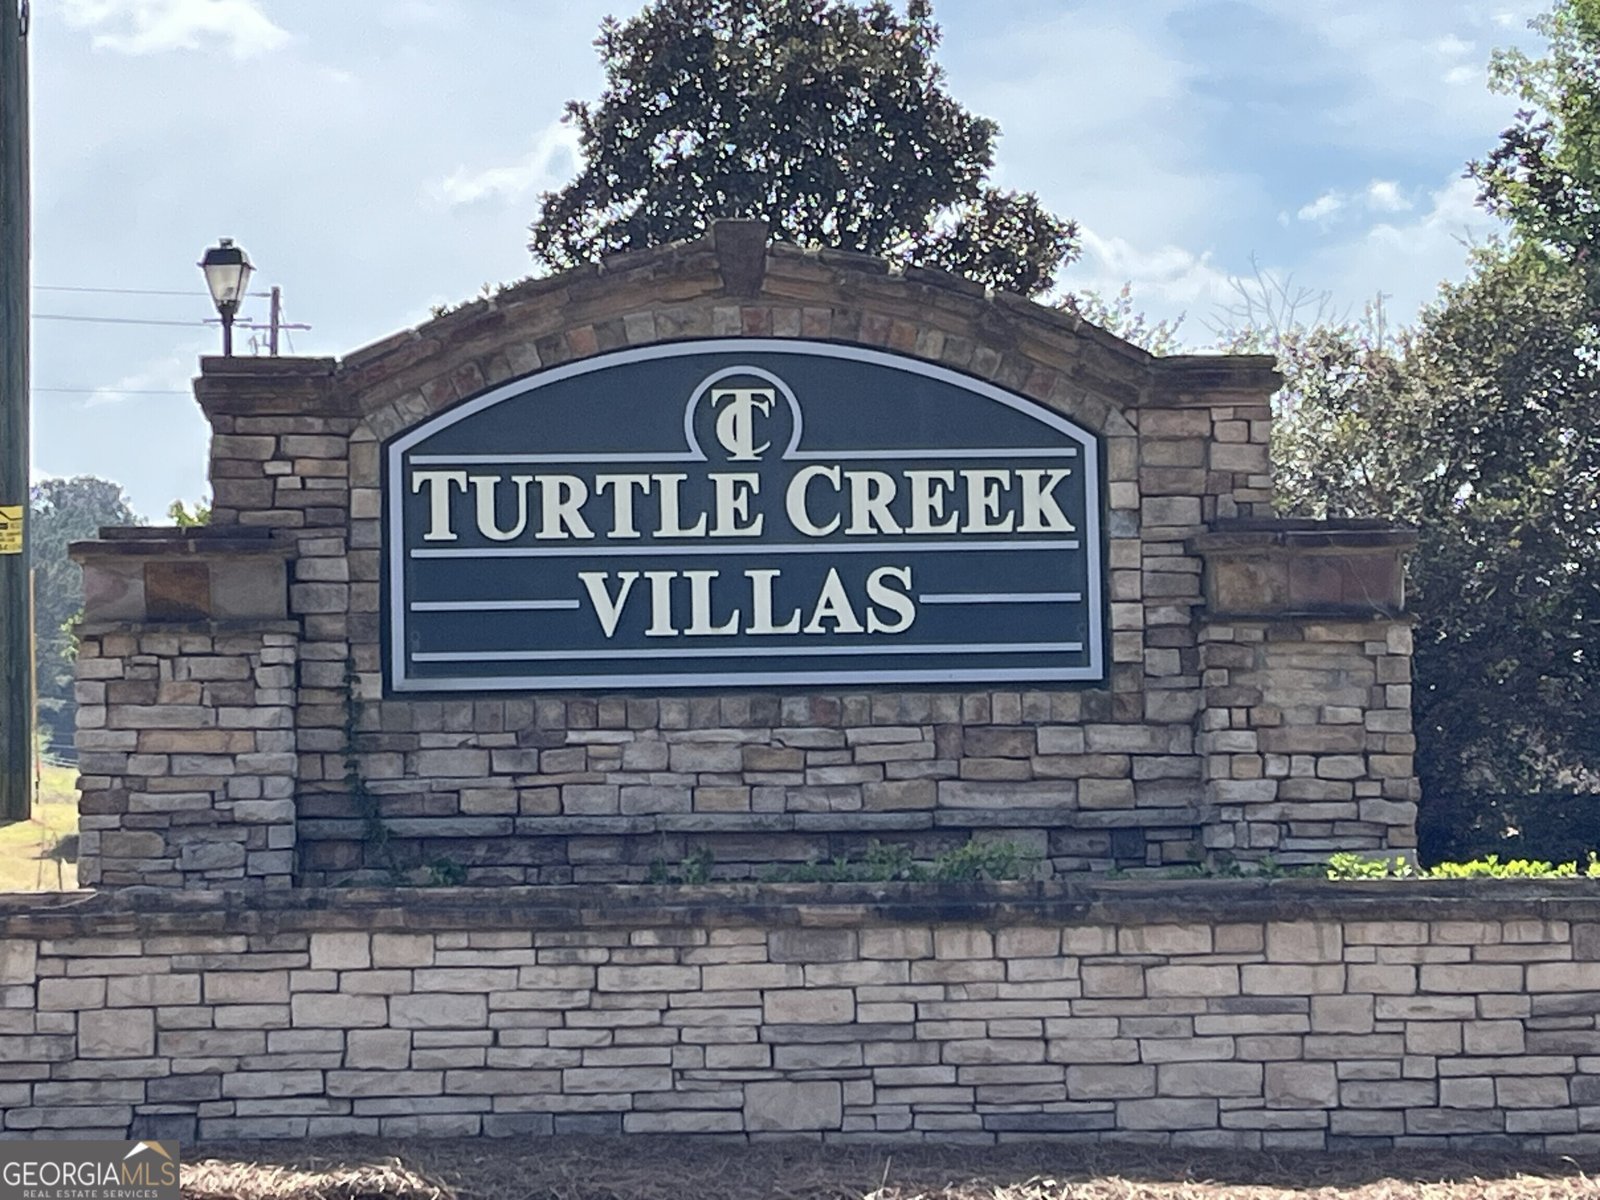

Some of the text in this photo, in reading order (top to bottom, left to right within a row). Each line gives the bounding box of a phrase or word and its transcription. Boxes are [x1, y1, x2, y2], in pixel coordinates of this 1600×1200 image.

[411, 465, 1076, 541] TURTLE CREEK
[578, 566, 917, 638] VILLAS
